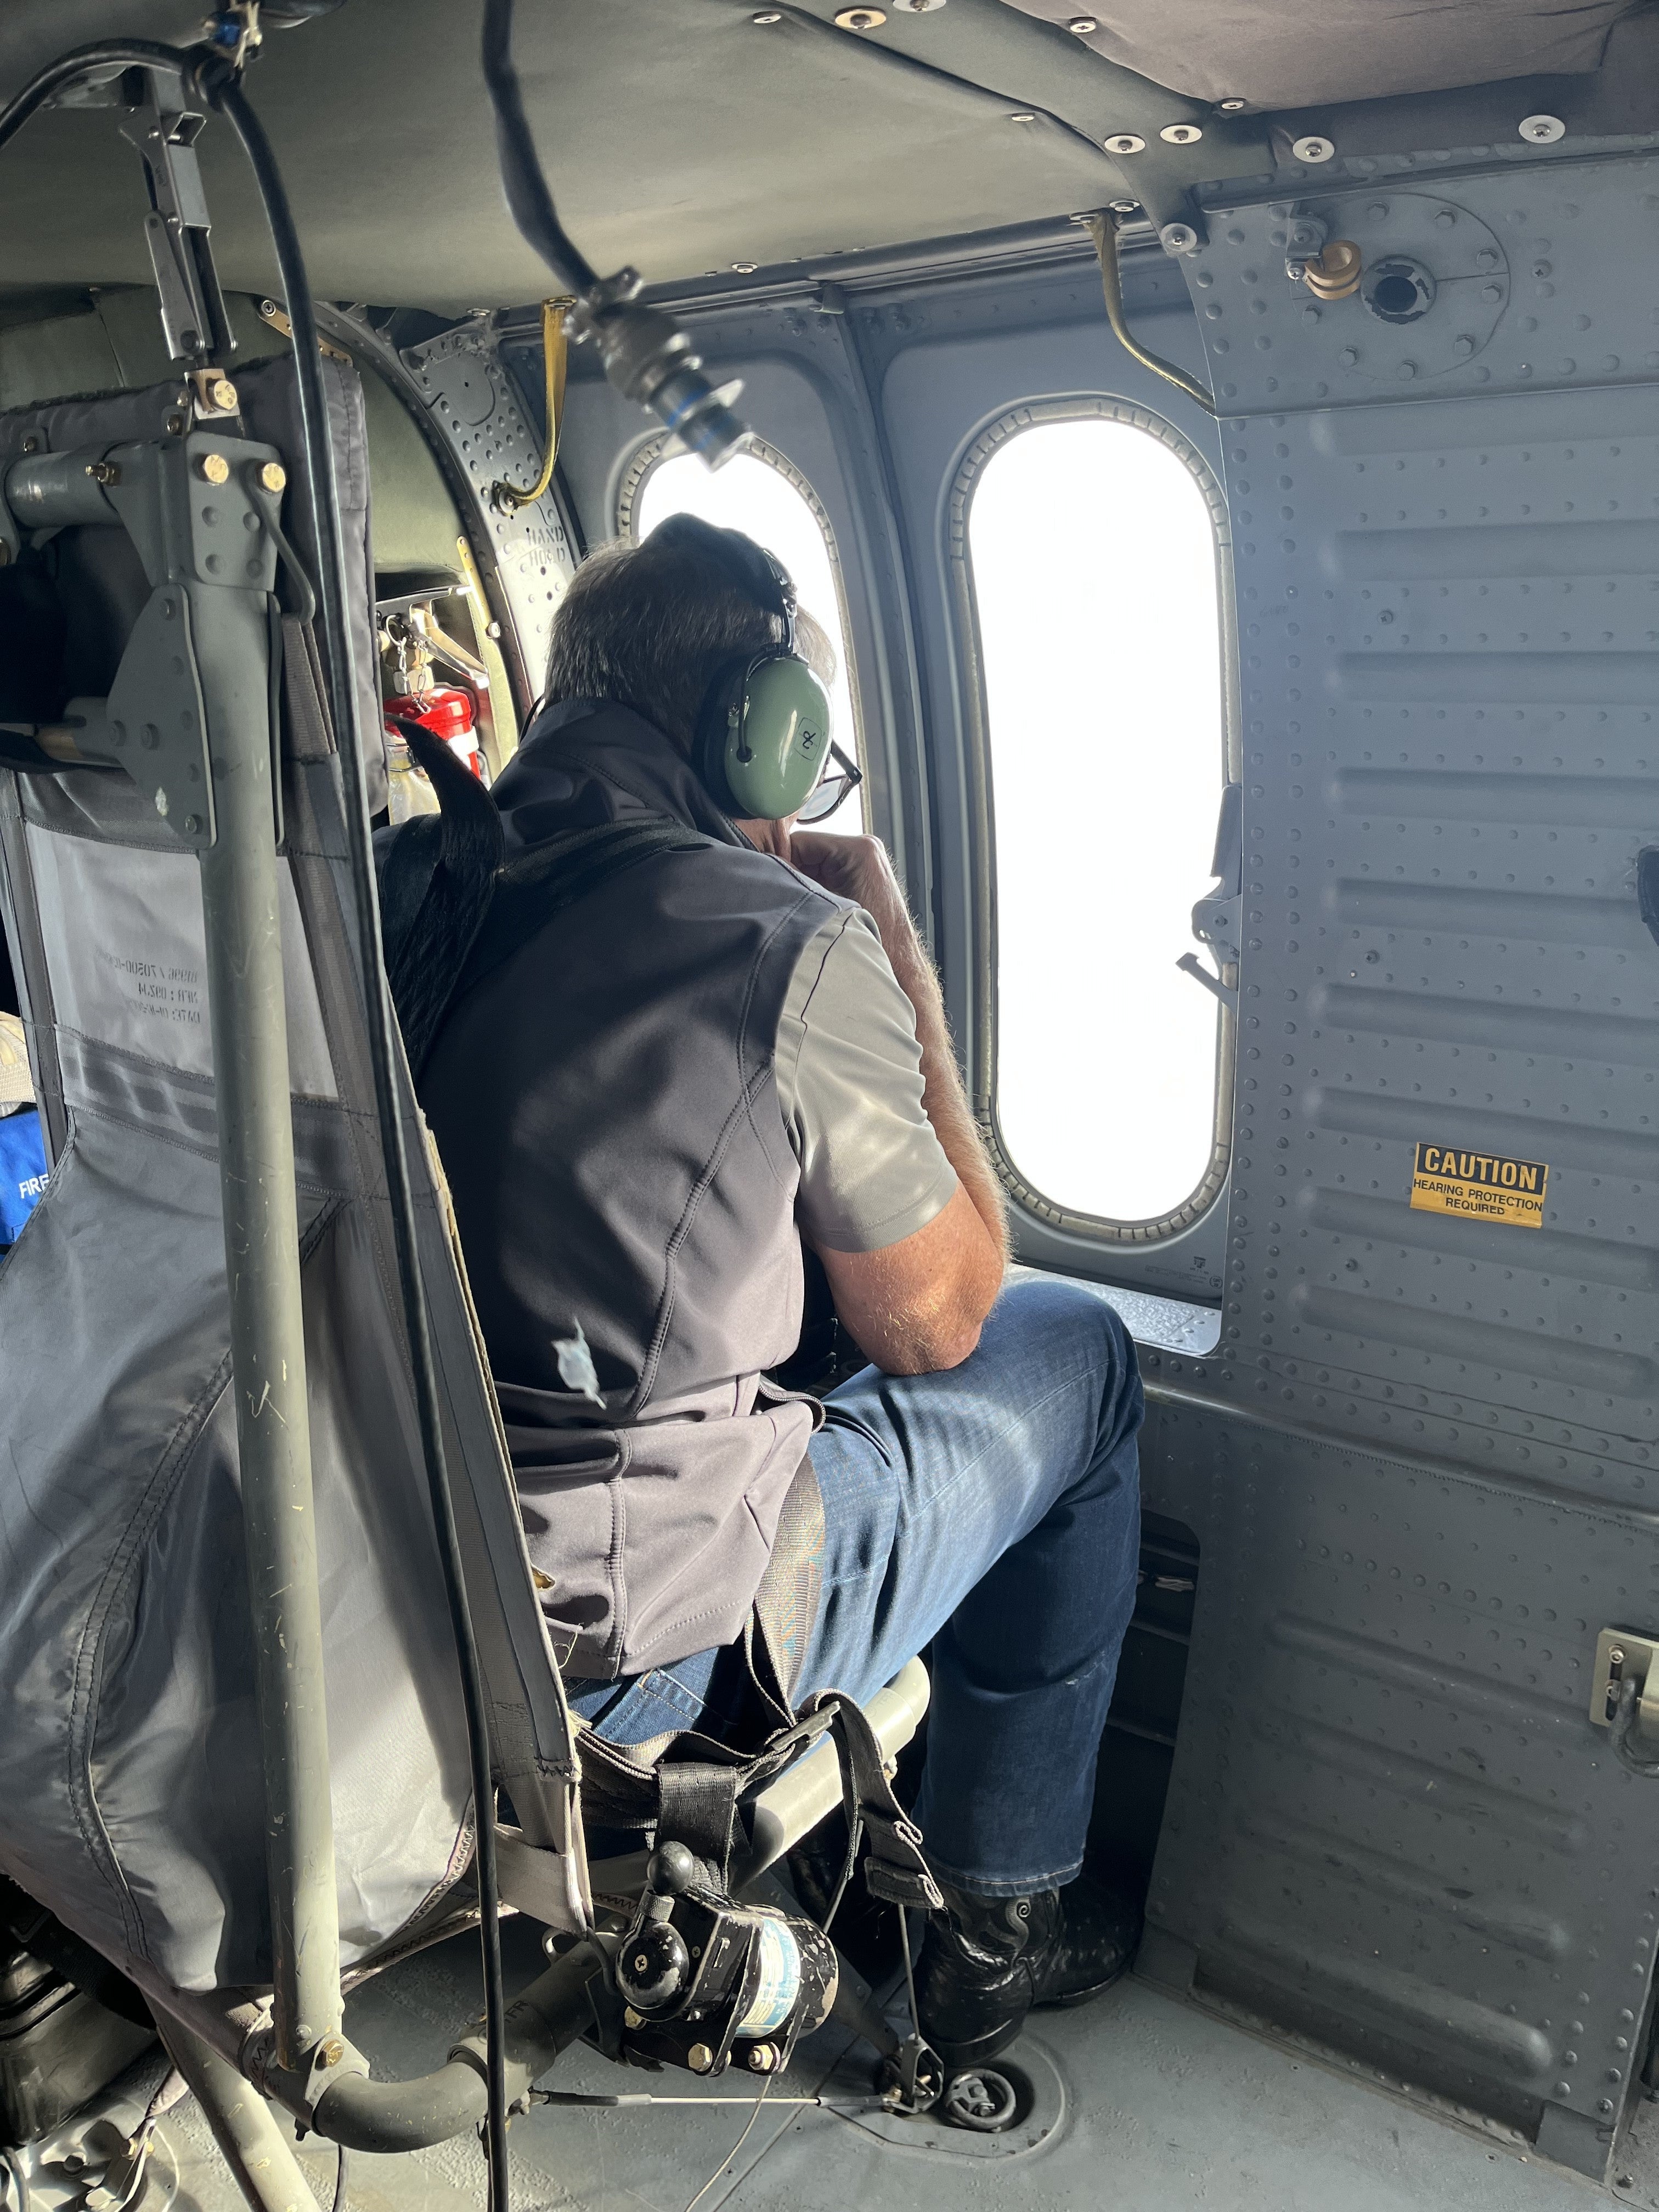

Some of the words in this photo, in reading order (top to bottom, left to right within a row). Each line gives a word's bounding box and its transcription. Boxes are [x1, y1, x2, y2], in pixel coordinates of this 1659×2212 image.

[1425, 1148, 1537, 1190] CAUTION
[1413, 1178, 1463, 1196] HEARING
[1468, 1189, 1543, 1211] PROTECTION
[1446, 1197, 1505, 1215] REQUIRED
